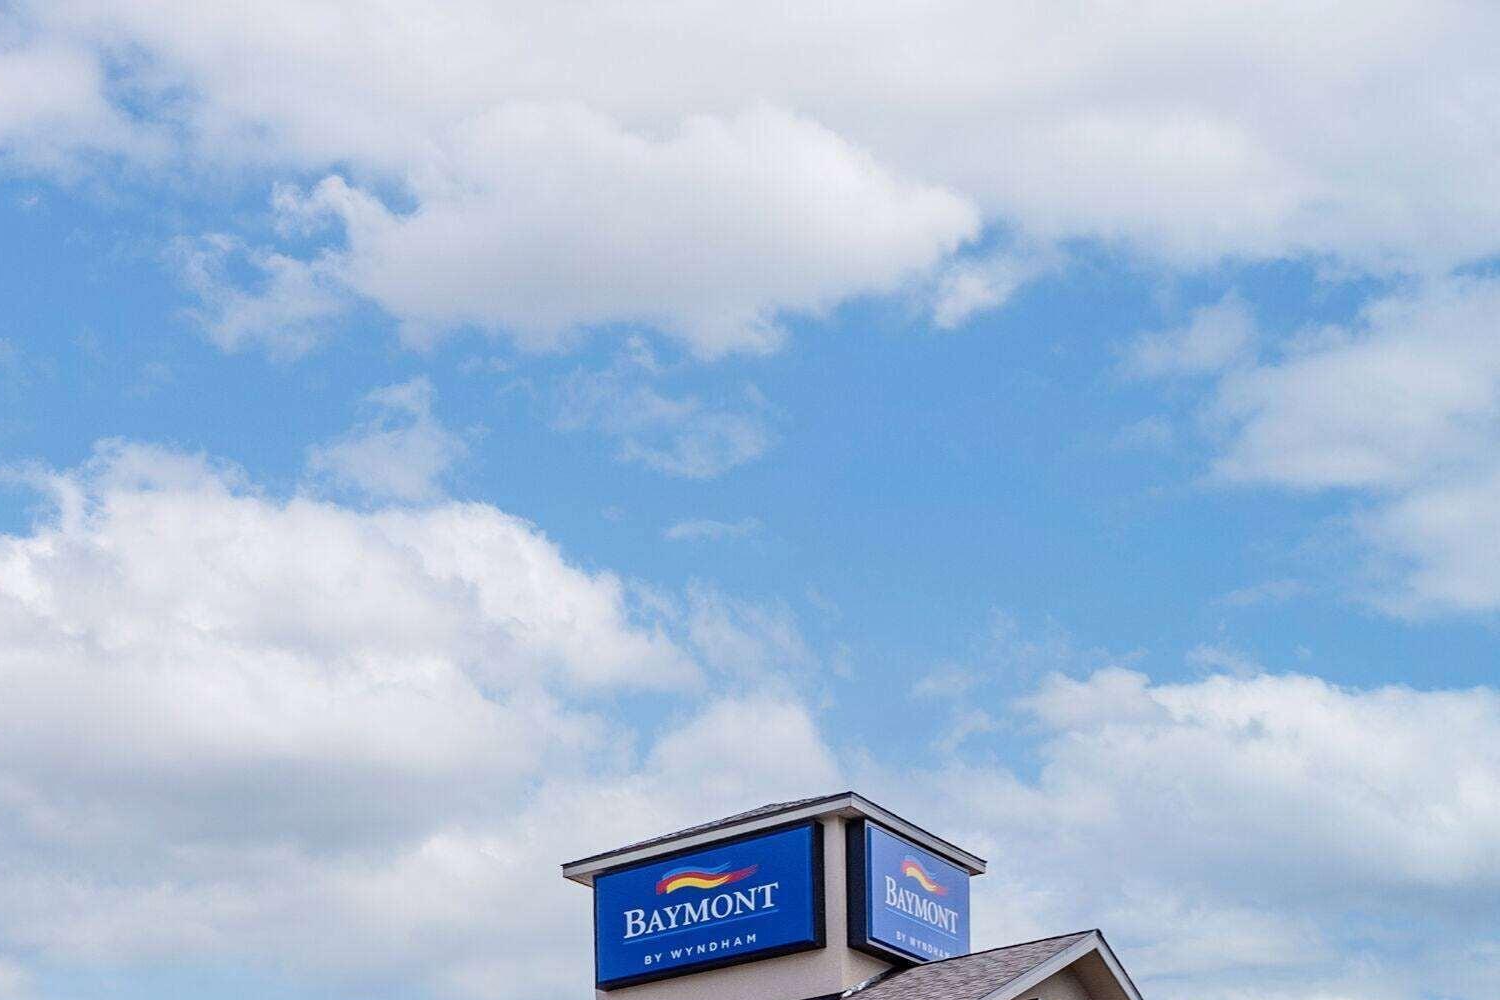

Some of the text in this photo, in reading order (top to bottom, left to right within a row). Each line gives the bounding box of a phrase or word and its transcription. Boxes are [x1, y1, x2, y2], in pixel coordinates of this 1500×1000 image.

[623, 881, 779, 939] BAYMONT
[884, 875, 958, 934] BAYMONT
[644, 933, 757, 966] BY WYNDHAM
[896, 930, 906, 942] BY
